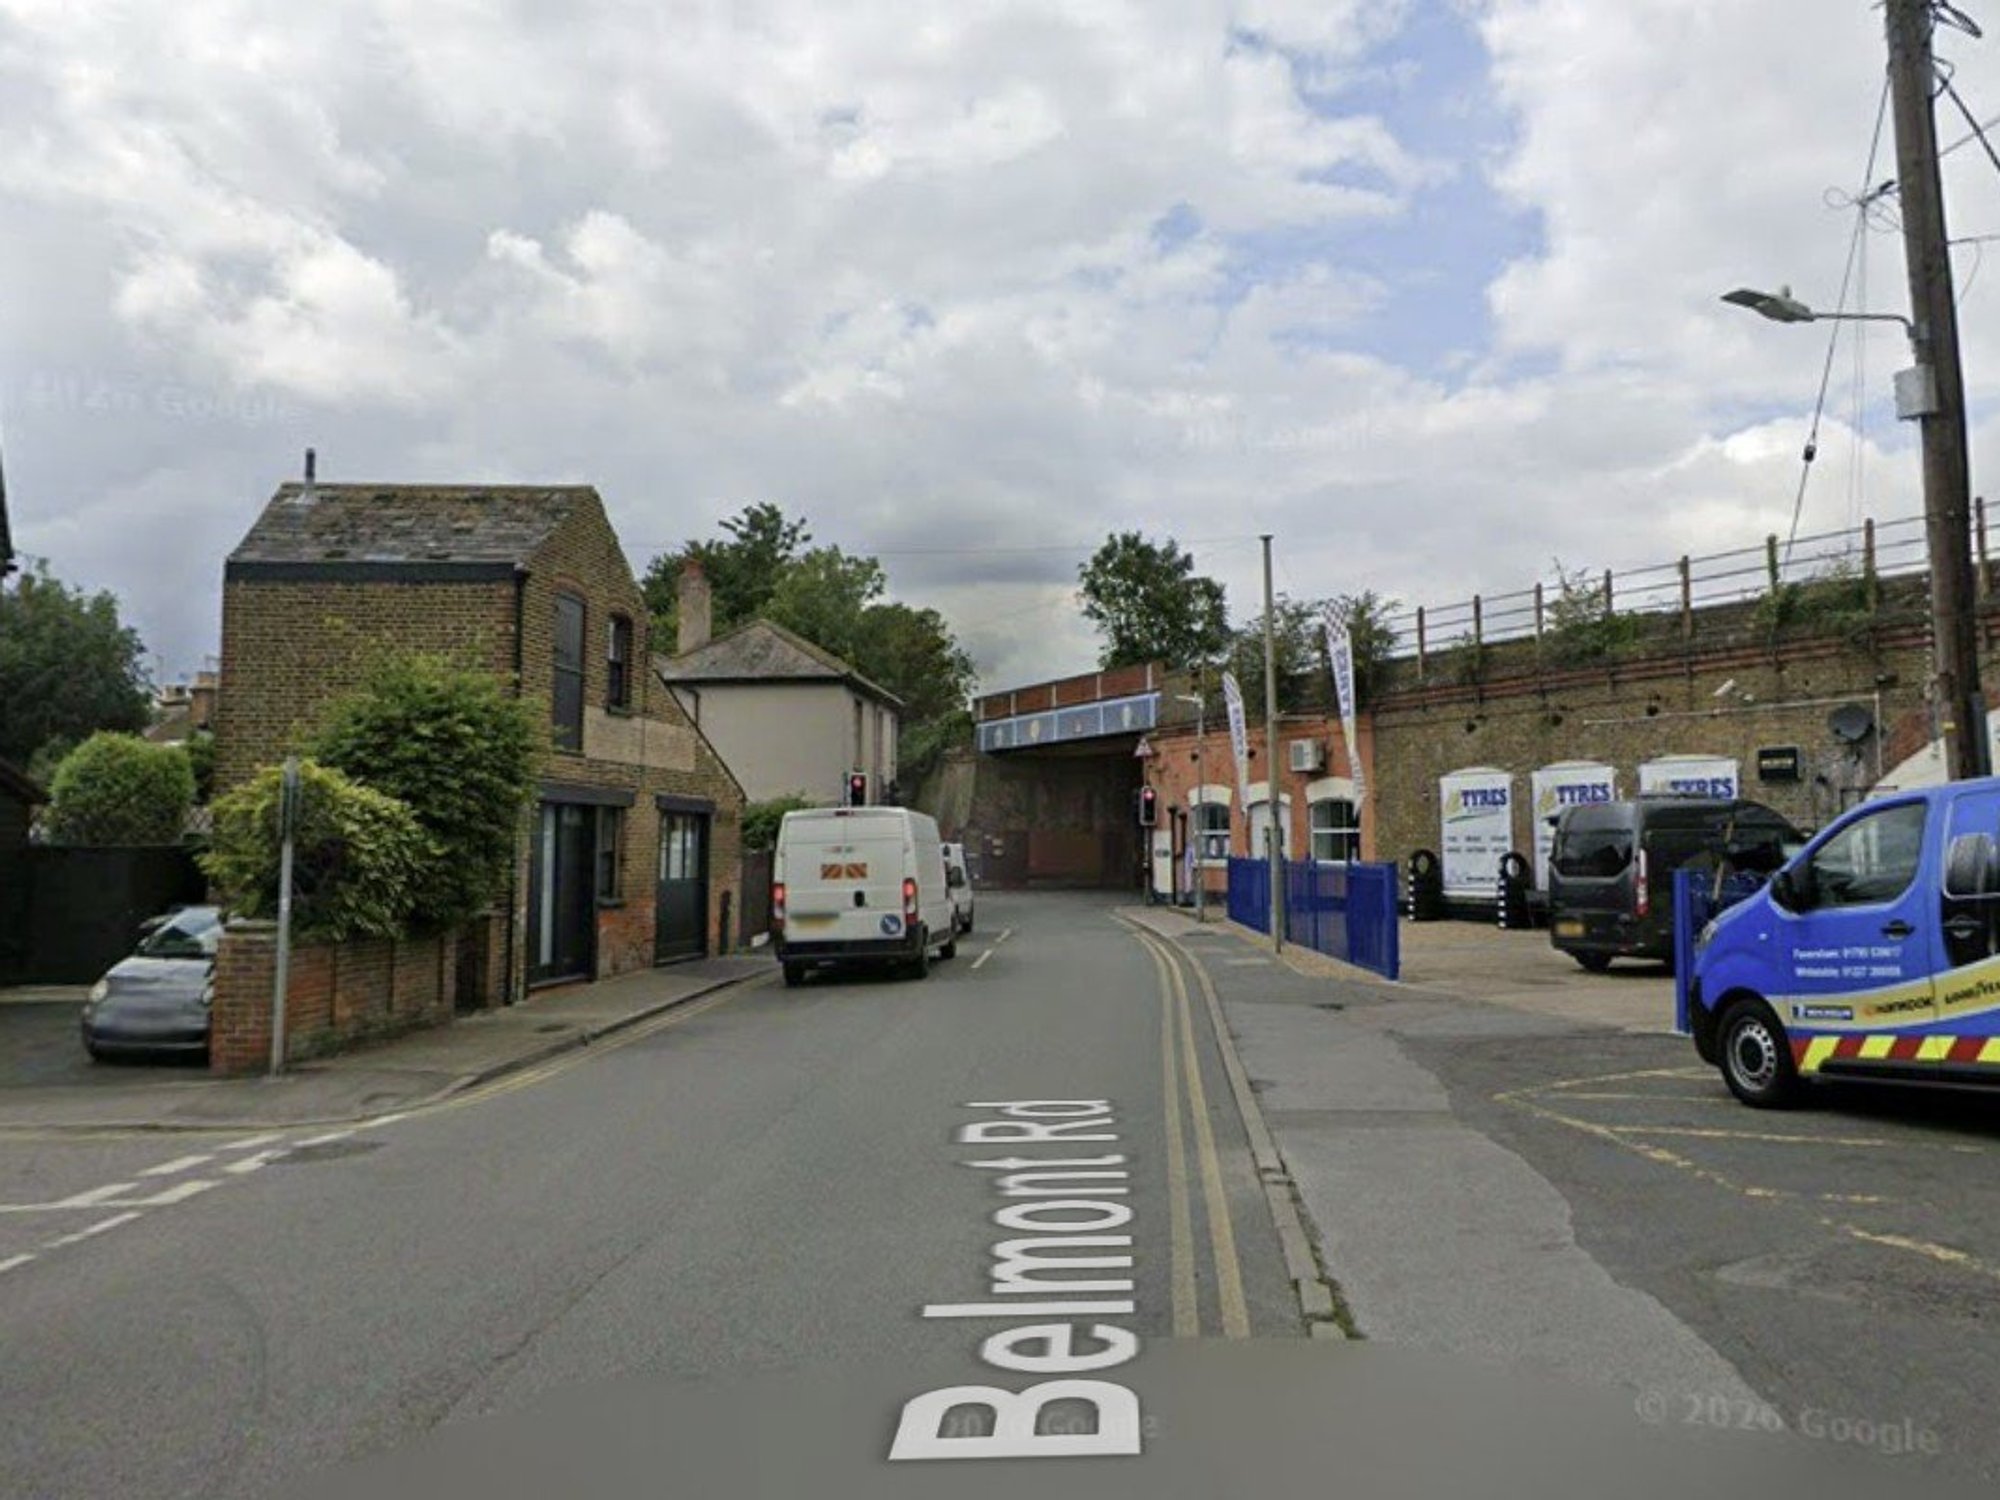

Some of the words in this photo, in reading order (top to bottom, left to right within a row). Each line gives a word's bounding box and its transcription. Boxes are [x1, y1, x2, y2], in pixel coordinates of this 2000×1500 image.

[1461, 788, 1507, 807] TYRES
[1556, 783, 1610, 804] TYRES
[1671, 778, 1733, 799] TYRES
